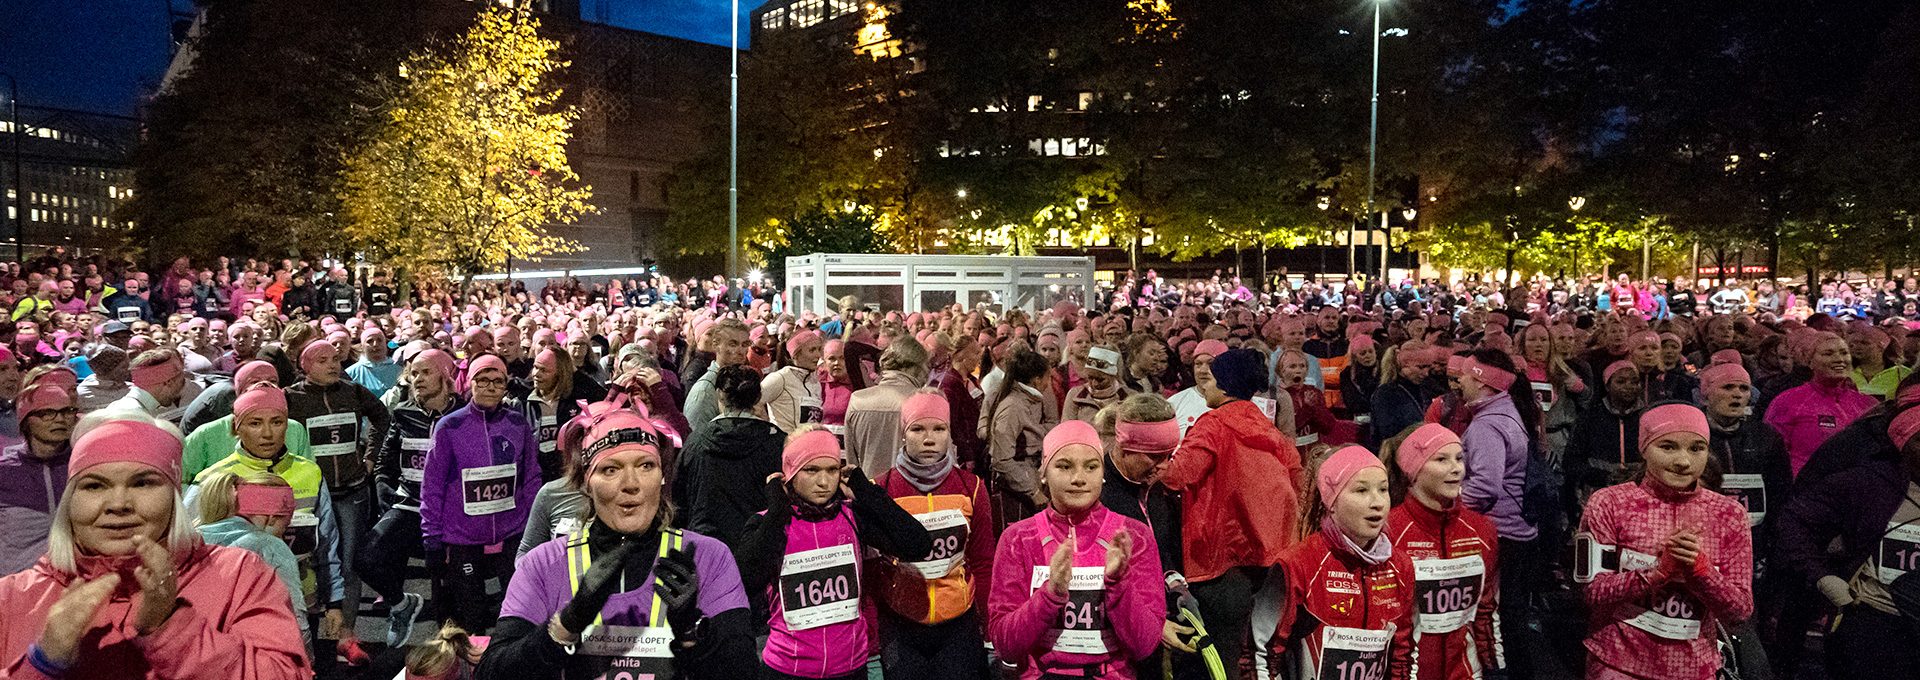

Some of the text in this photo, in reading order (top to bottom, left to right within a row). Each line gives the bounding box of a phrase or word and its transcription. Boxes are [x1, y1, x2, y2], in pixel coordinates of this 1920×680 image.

[330, 430, 340, 444] 5
[540, 427, 558, 440] 97
[473, 483, 508, 502] 1423
[794, 574, 849, 608] 1640
[1326, 580, 1360, 590] FOSS
[1423, 585, 1474, 613] 1005
[583, 634, 602, 643] ROSA
[1358, 651, 1377, 660] Julie
[610, 657, 641, 668] Anita
